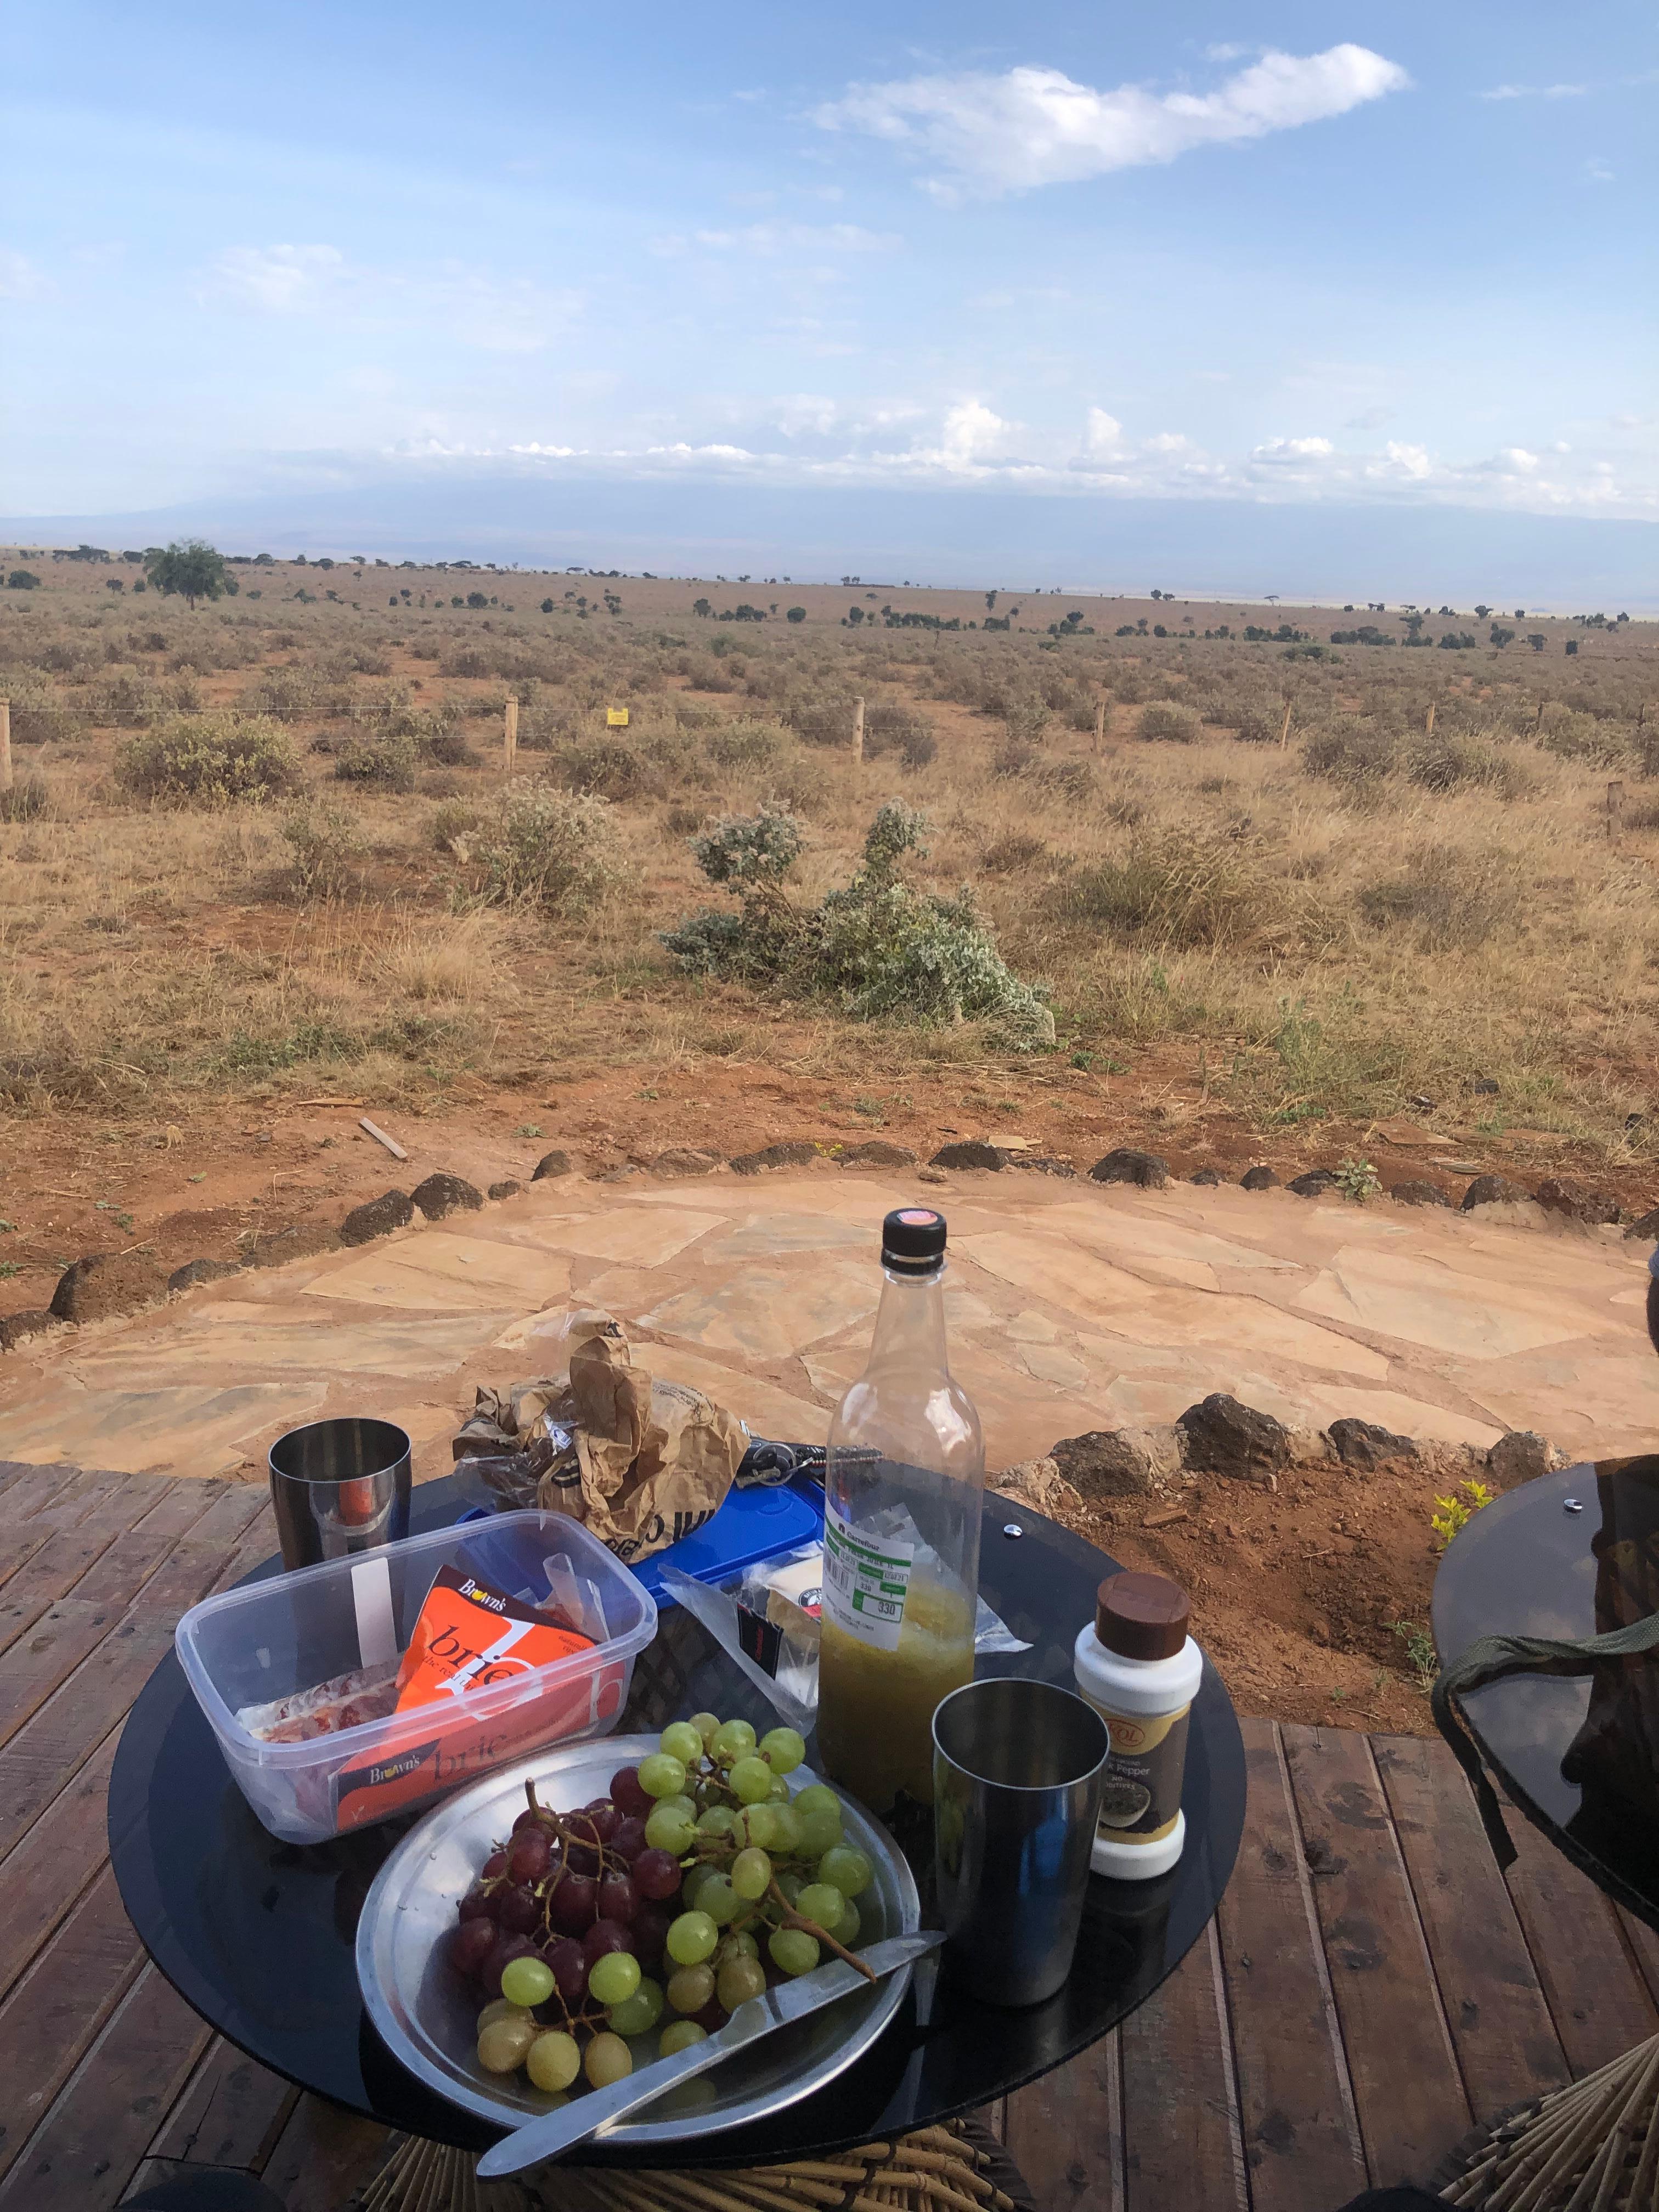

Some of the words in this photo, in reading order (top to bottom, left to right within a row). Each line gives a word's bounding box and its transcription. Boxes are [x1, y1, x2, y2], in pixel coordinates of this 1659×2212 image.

[847, 1531, 880, 1551] Carrefour
[458, 1578, 506, 1612] Brown's
[878, 1600, 896, 1615] 330
[428, 1624, 514, 1685] brie
[422, 1655, 439, 1668] the
[439, 1666, 461, 1682] real
[369, 1754, 420, 1784] Brown's
[1117, 1763, 1150, 1776] Pepper
